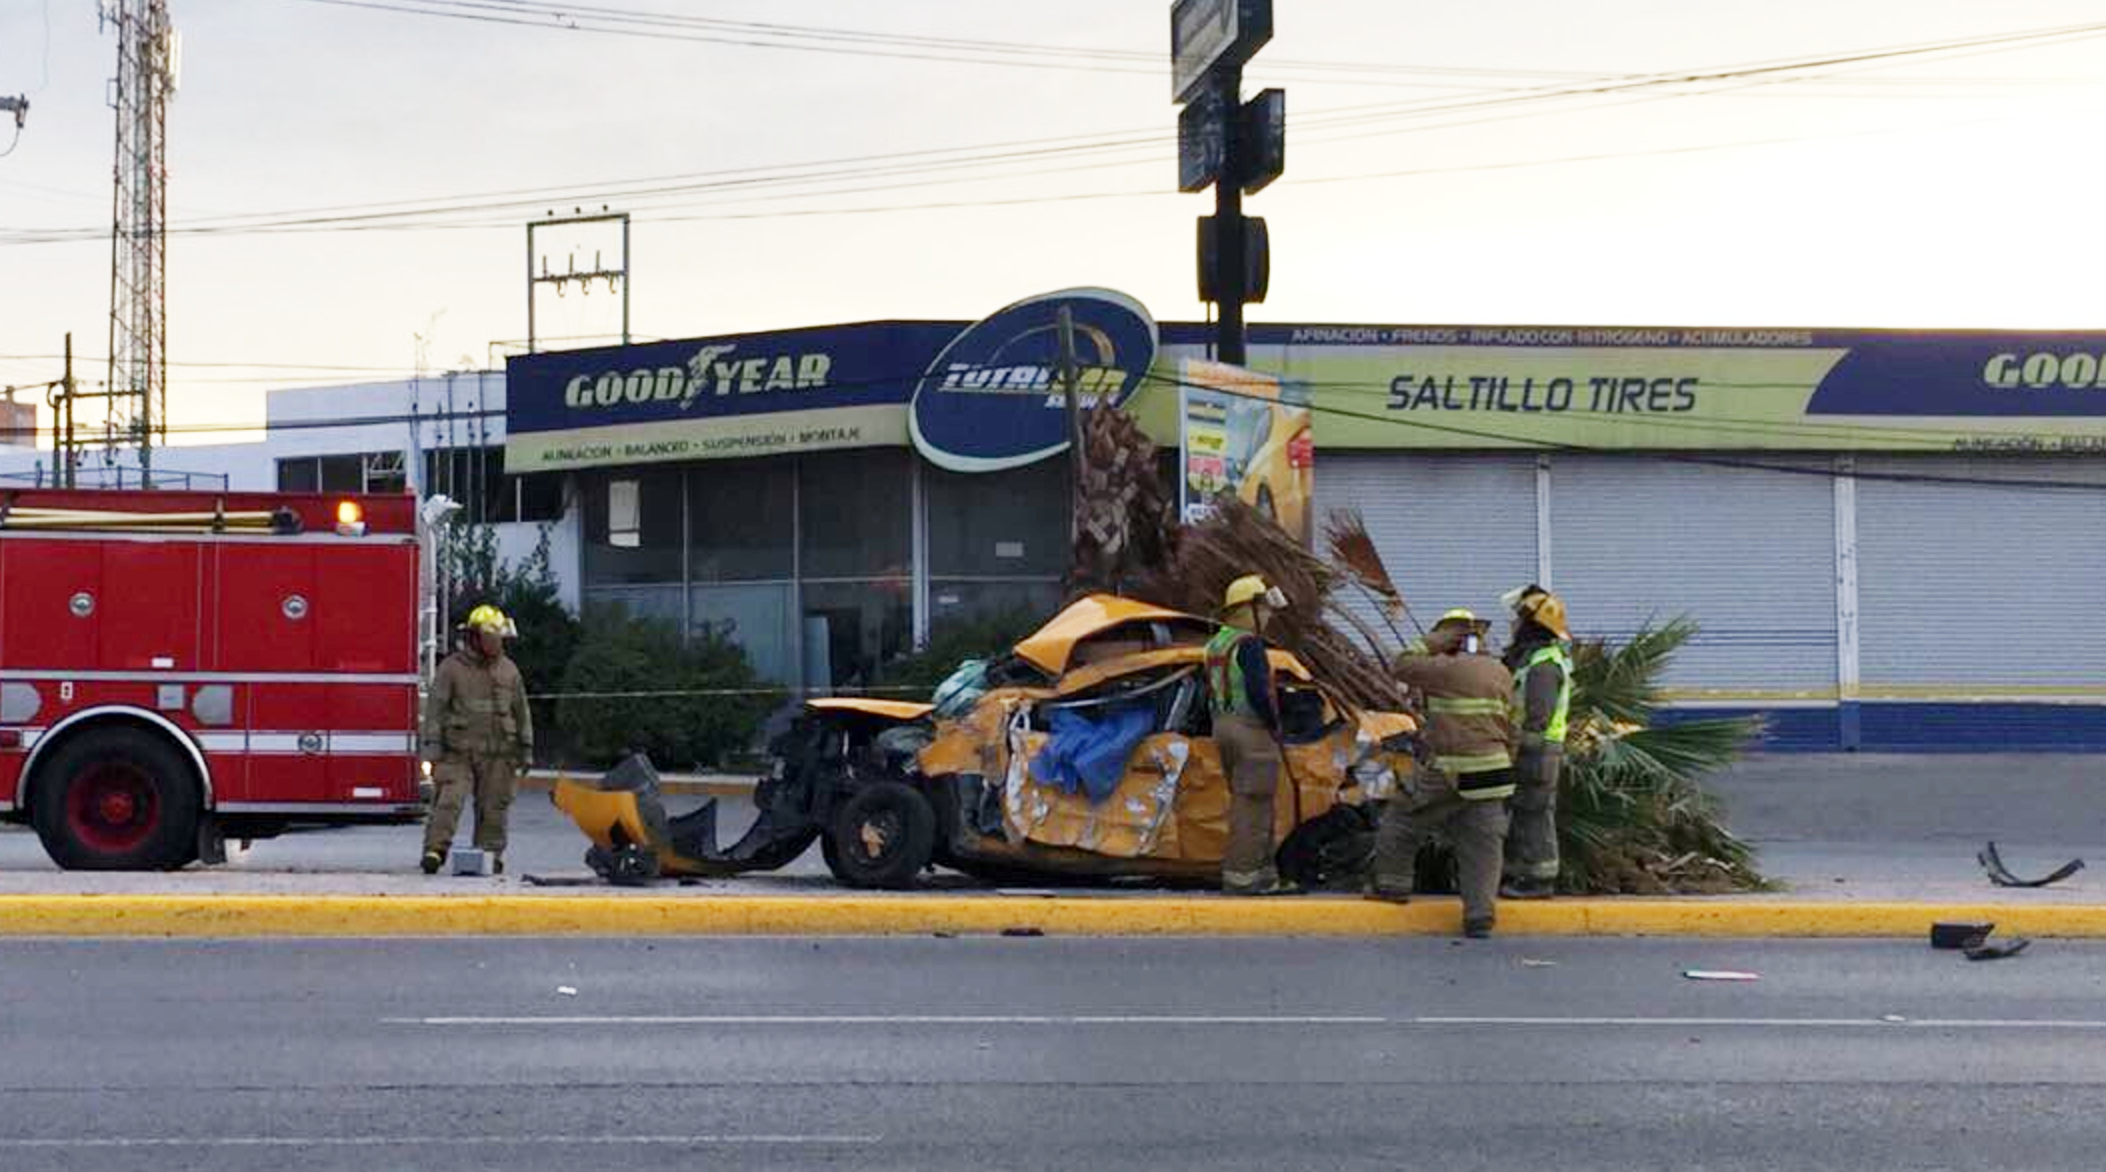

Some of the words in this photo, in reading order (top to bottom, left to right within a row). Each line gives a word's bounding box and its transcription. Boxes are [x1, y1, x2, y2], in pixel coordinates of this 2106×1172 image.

[1392, 329, 1457, 344] FRENOS
[1540, 330, 1572, 345] CON
[1680, 330, 1813, 346] ACUMULADORES
[1984, 353, 2106, 388] GOO
[1386, 375, 1573, 412] SALTILLO
[1588, 376, 1699, 412] TIRES
